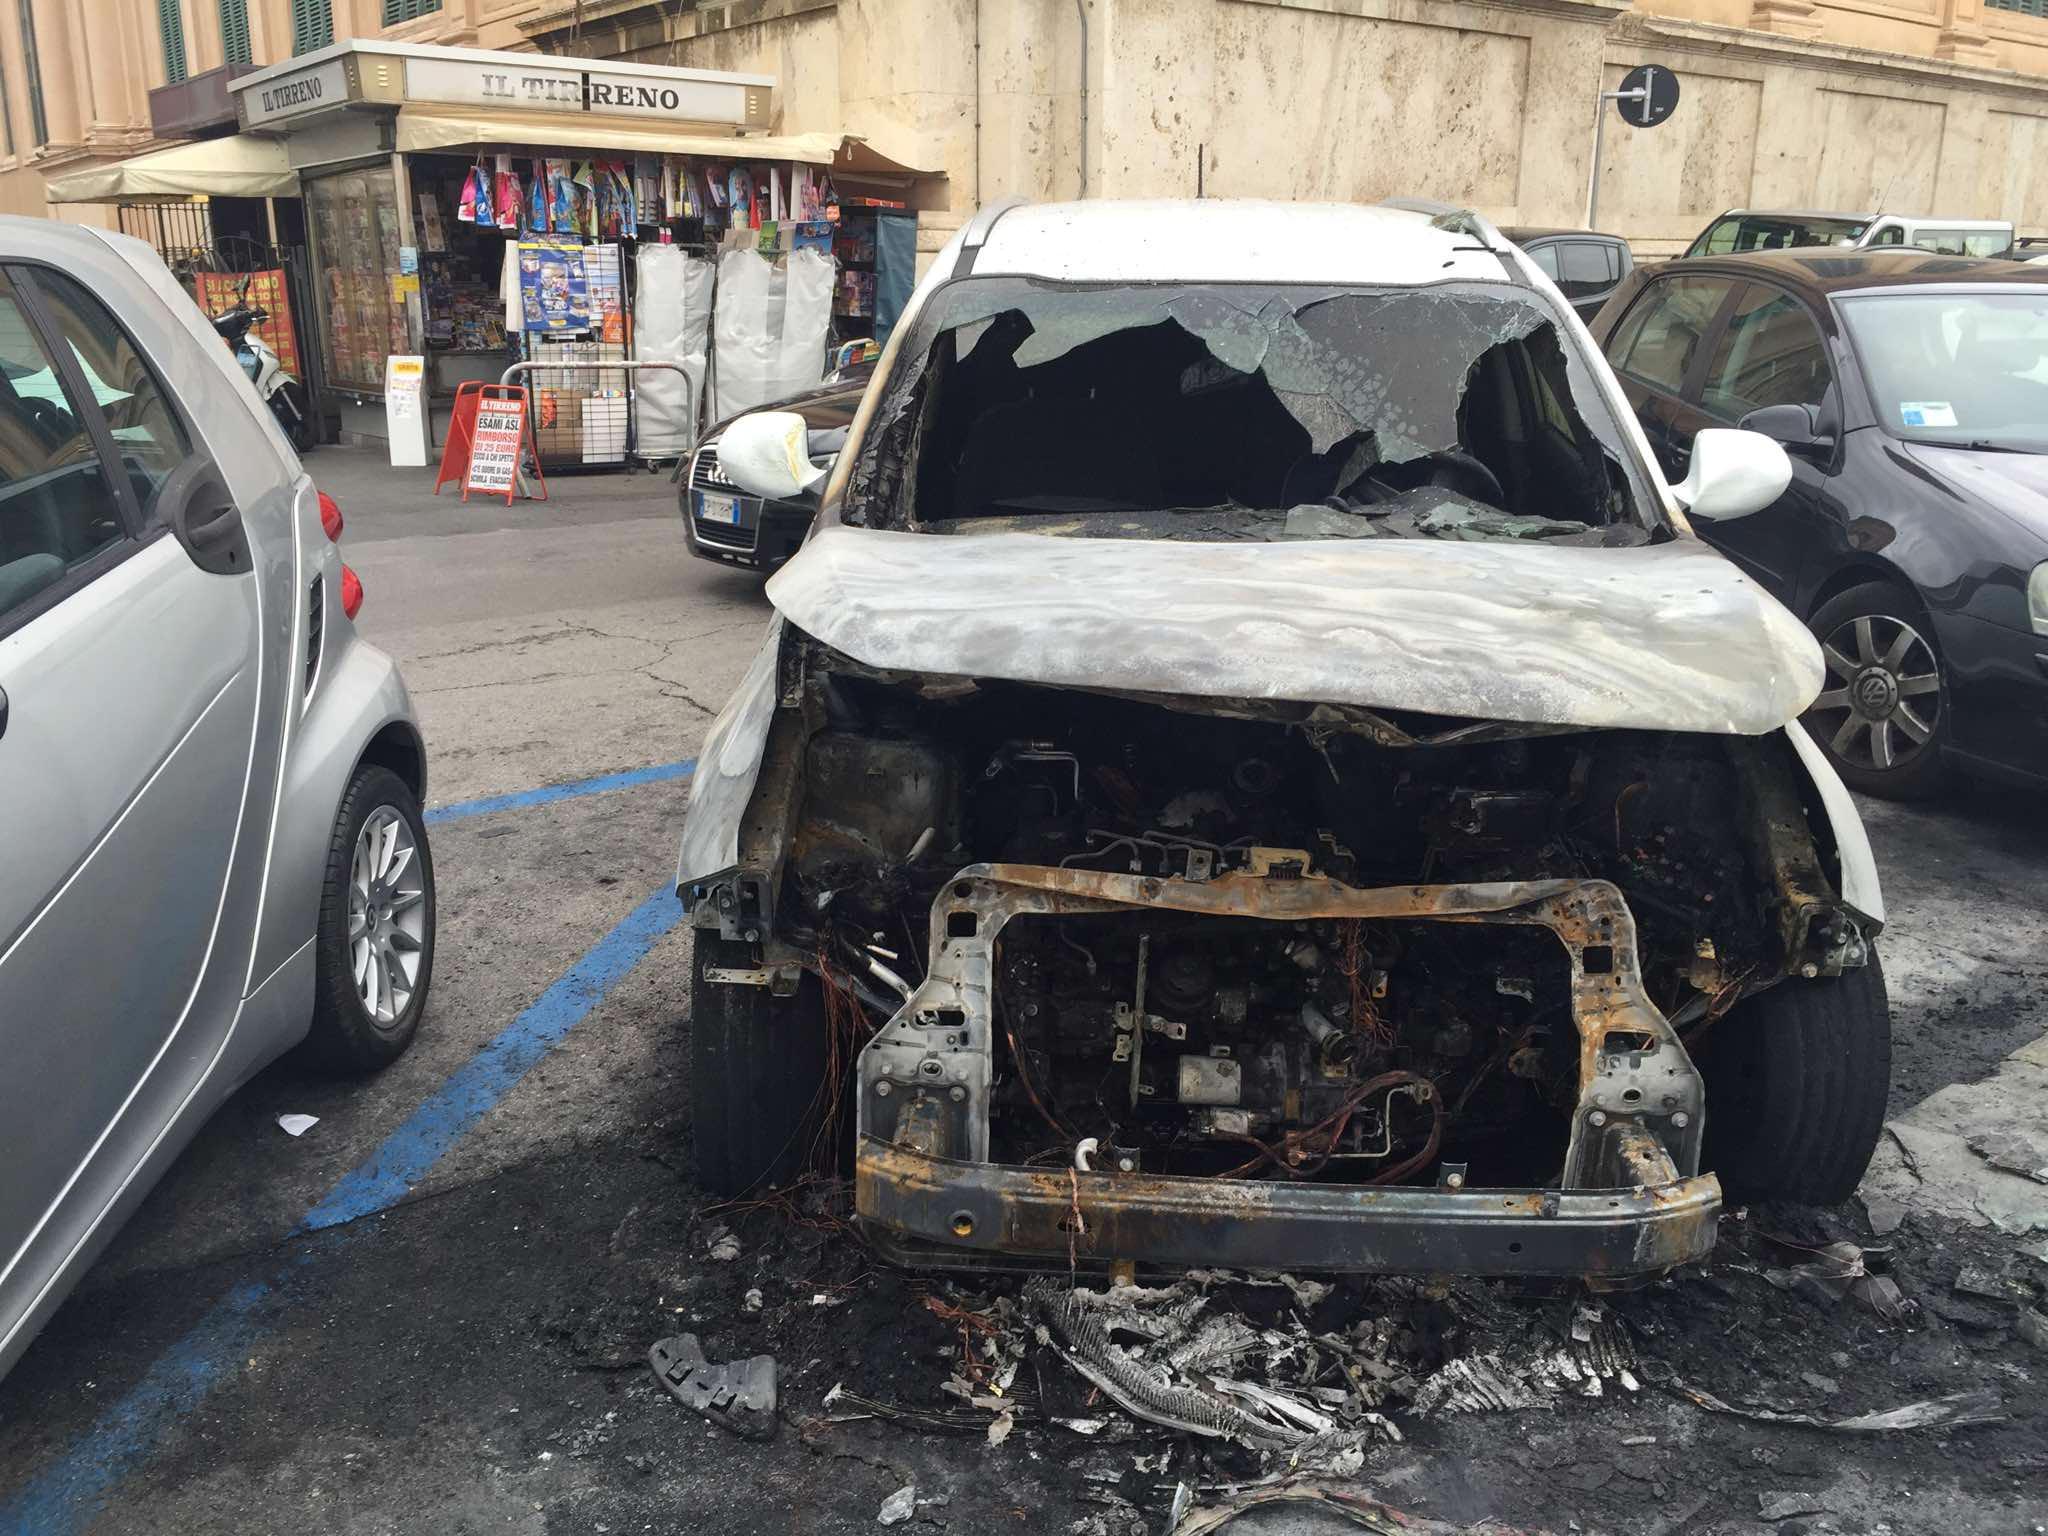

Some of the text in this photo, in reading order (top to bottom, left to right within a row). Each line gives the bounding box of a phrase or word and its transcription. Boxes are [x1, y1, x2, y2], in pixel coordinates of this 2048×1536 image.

[262, 77, 322, 112] IL TIRRENO
[482, 74, 680, 110] IL TIRRENO
[479, 418, 520, 431] ESAMI ASL
[477, 431, 517, 443] RIMBORSO
[474, 442, 483, 451] DI
[495, 444, 516, 454] EURO
[489, 453, 498, 461] CHI
